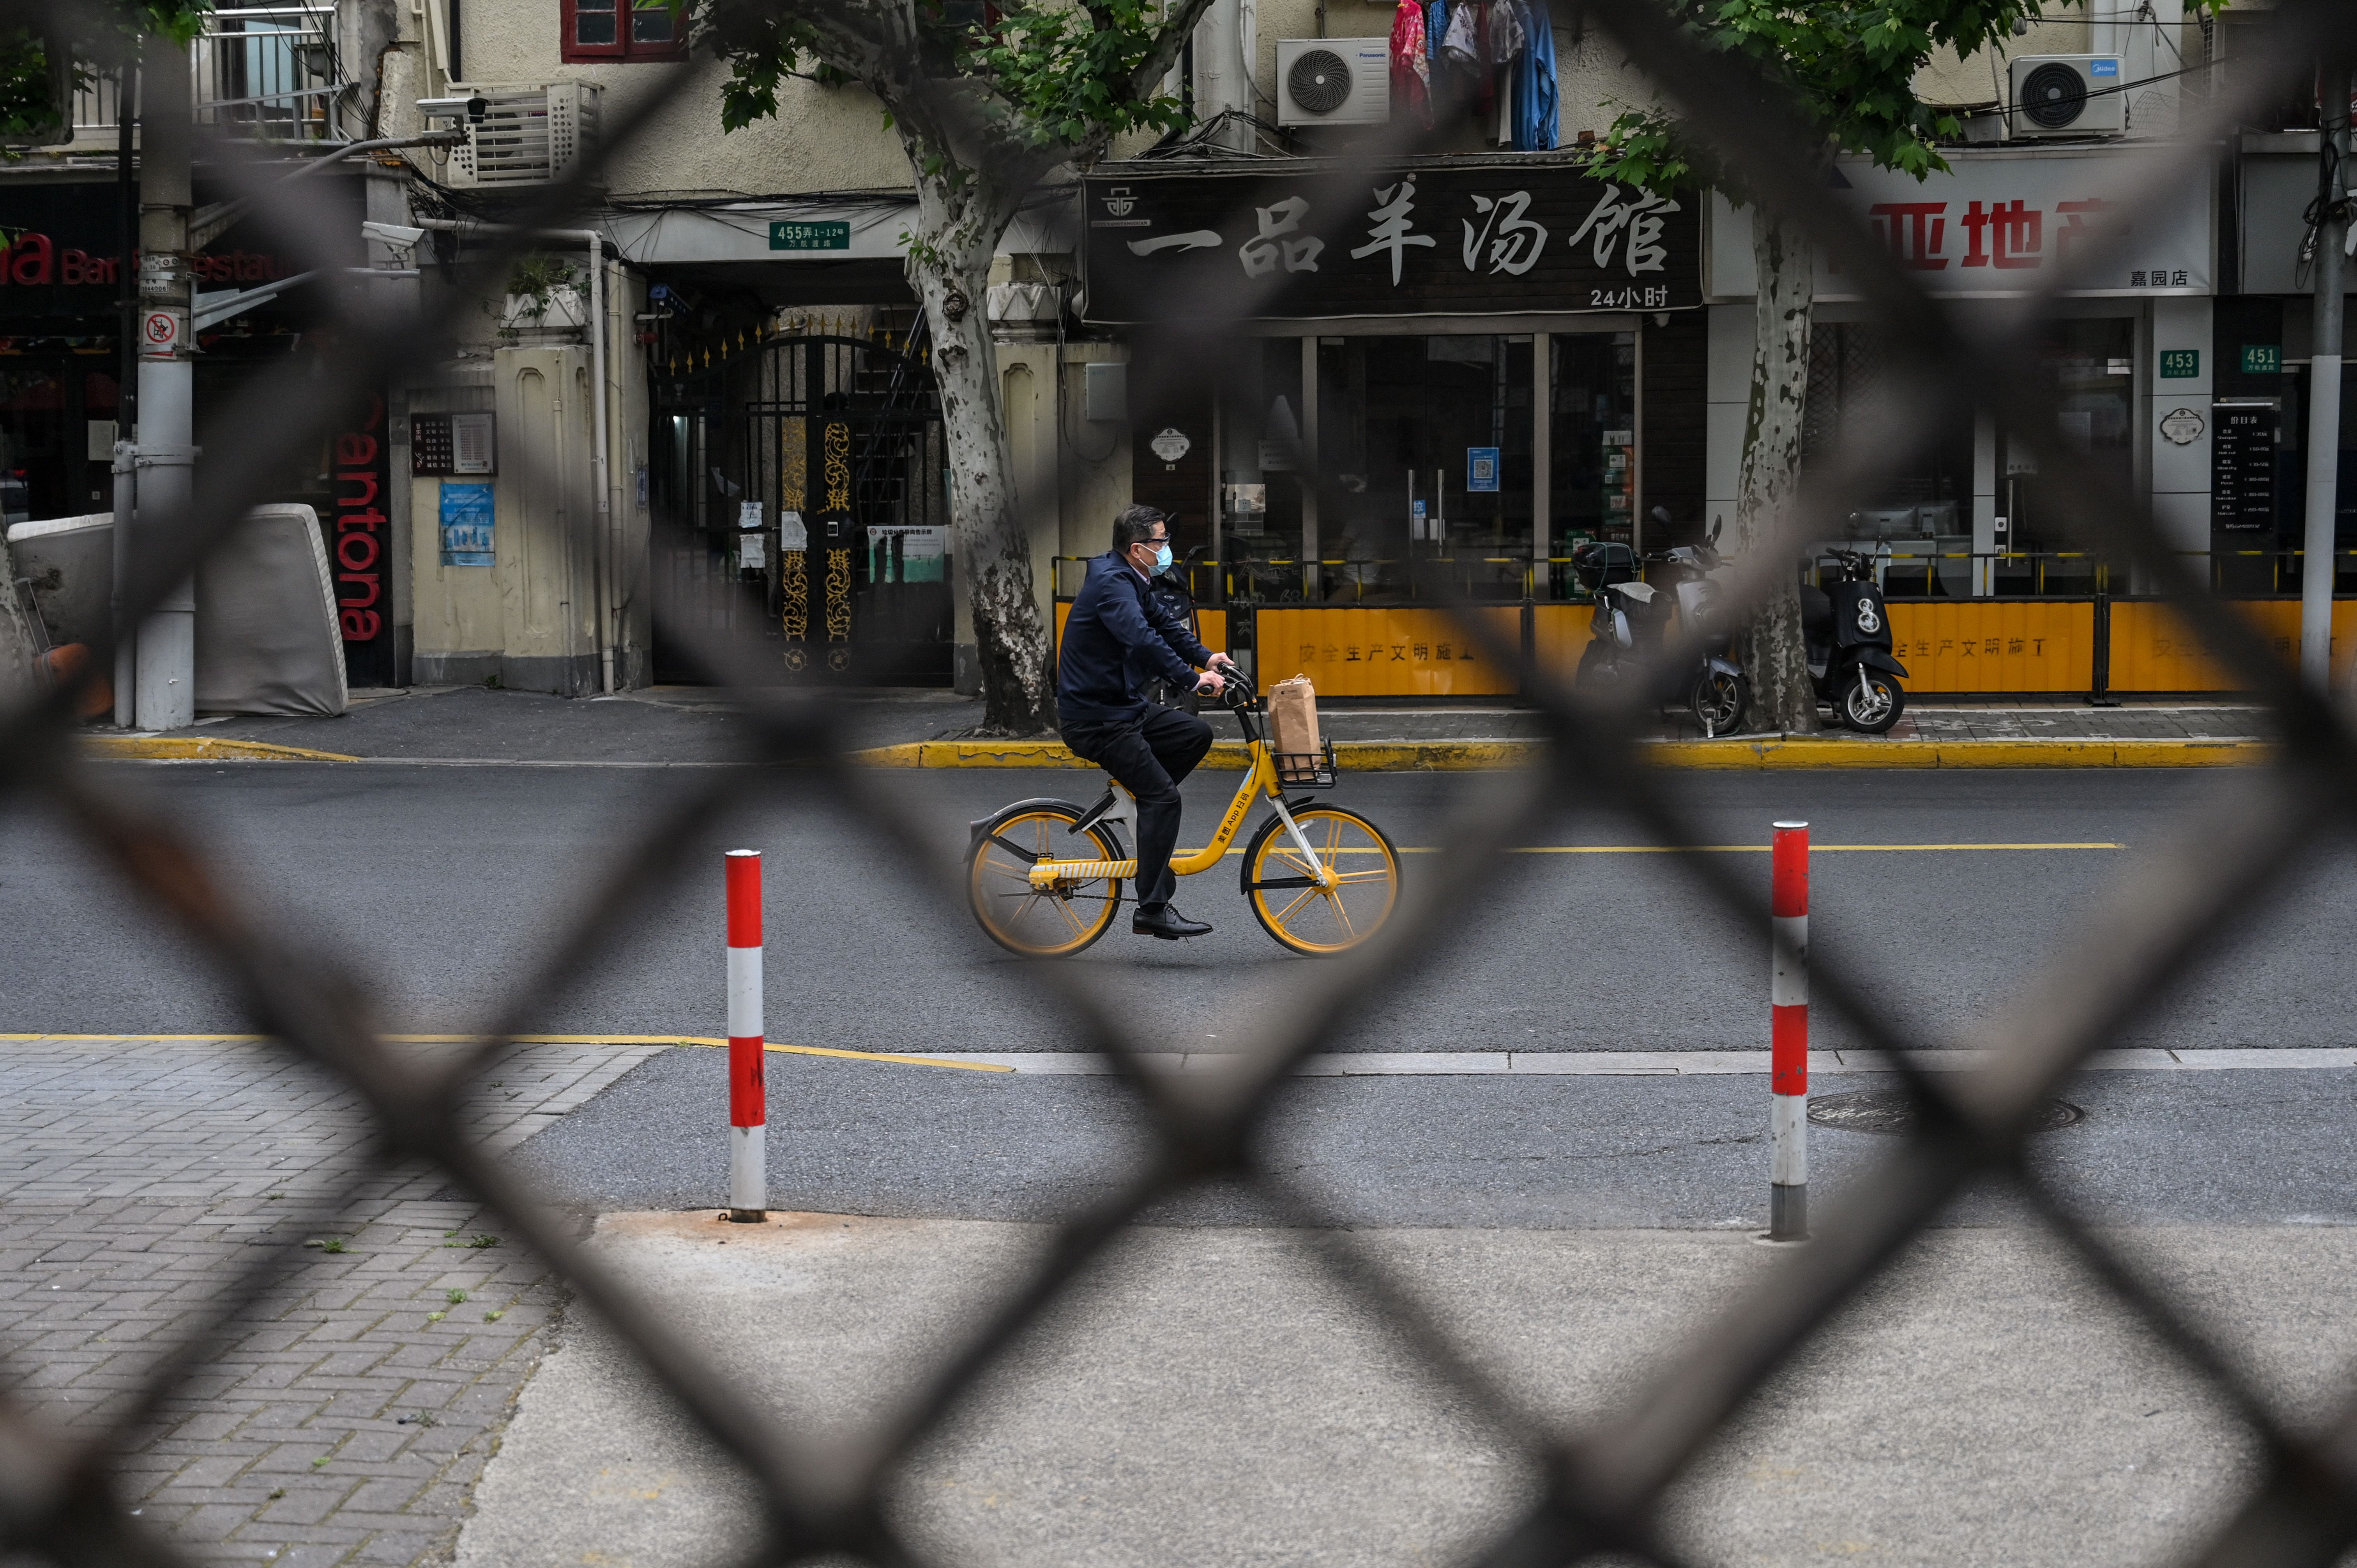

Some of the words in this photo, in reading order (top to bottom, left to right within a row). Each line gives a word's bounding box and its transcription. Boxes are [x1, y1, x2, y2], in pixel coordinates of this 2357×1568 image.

[1126, 182, 1681, 287] 一品羊汤馆
[62, 249, 121, 284] Bar
[2131, 270, 2188, 286] 嘉园店
[1590, 285, 1668, 308] 24小时
[2166, 353, 2193, 368] 453
[2247, 349, 2275, 363] 451
[1299, 642, 1474, 663] 安全生产文明施工
[1894, 638, 2045, 657] 全生产文明施工
